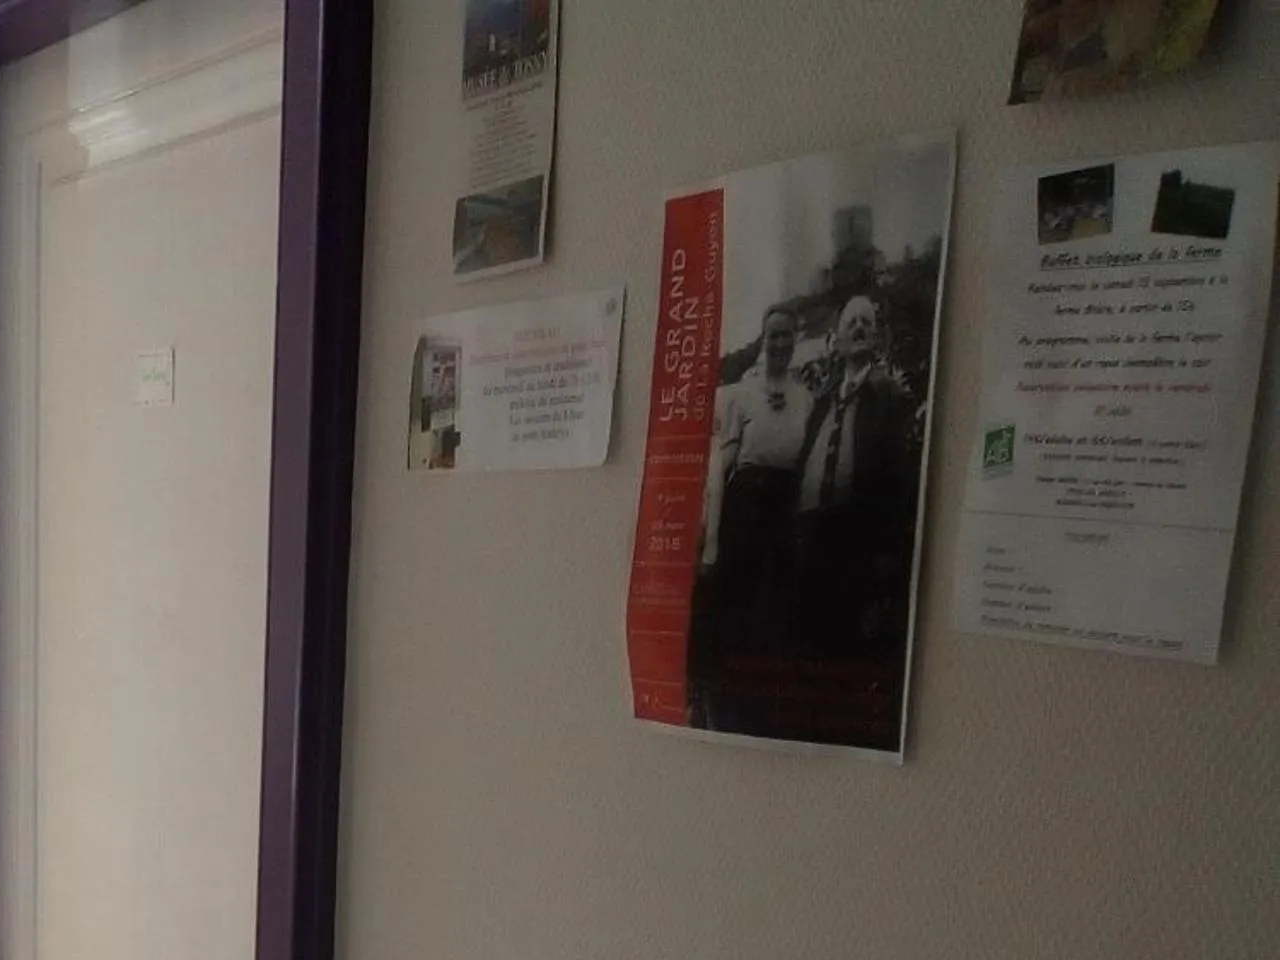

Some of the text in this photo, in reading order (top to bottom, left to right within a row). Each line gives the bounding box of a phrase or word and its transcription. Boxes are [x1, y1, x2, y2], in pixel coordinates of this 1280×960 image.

[659, 249, 686, 423] LE GRAND
[673, 296, 702, 422] JARDIN
